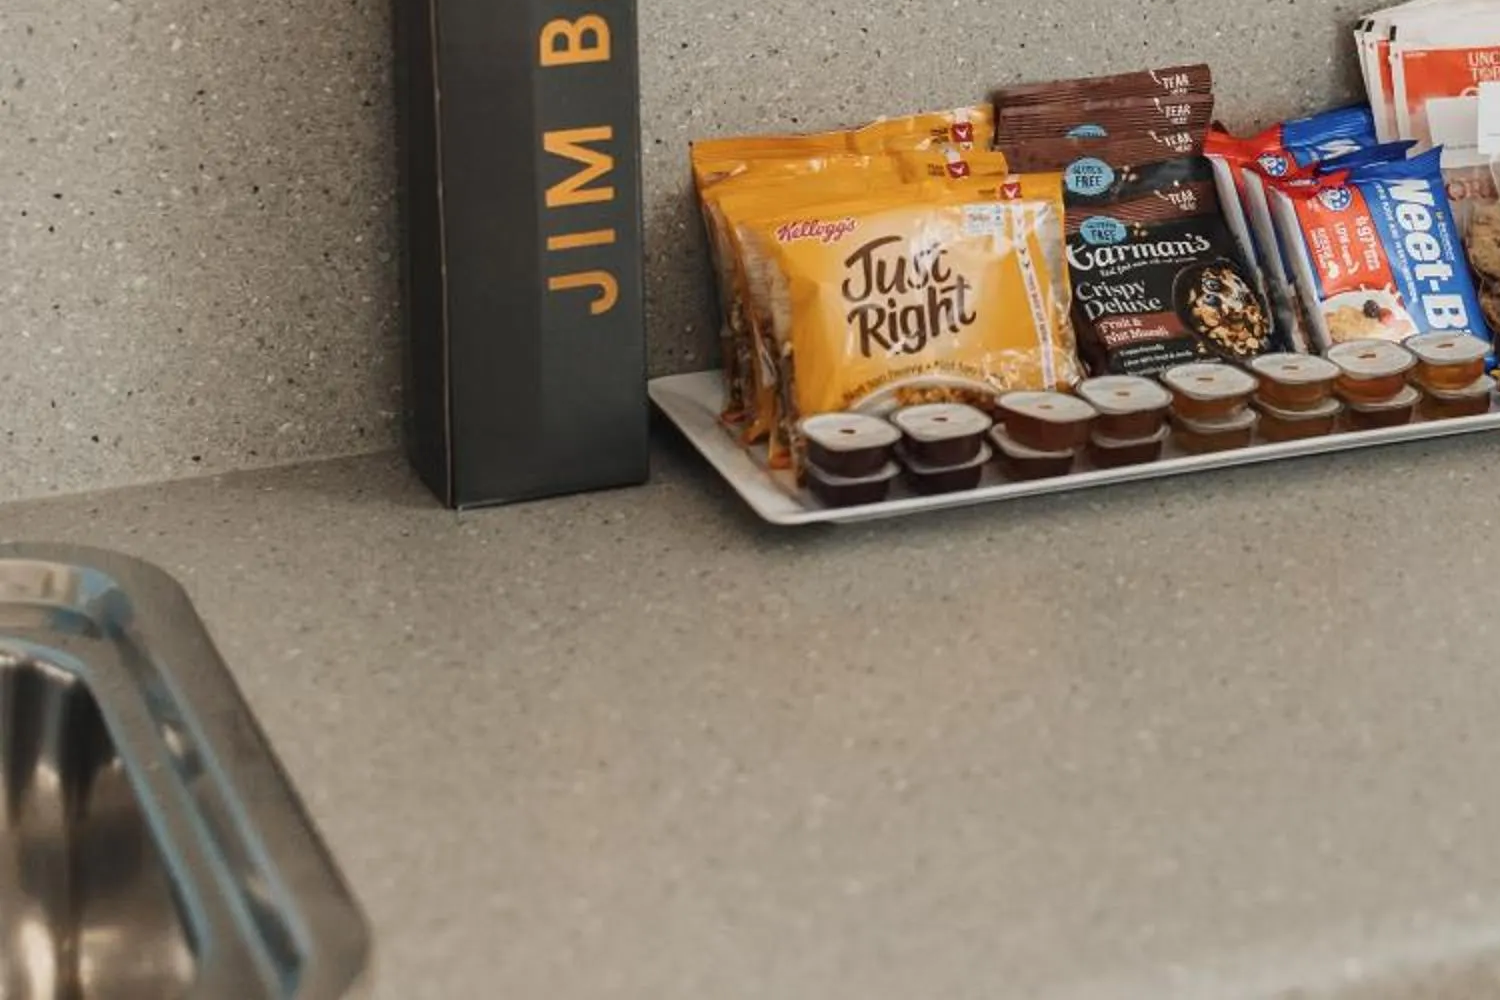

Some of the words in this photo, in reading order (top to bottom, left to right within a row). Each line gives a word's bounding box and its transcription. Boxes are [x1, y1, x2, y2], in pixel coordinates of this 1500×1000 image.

[1162, 73, 1190, 90] TEAR
[1165, 103, 1191, 118] TEAR
[1075, 175, 1102, 188] FREE
[543, 125, 618, 315] JIM
[777, 217, 858, 241] Kellogg's
[1066, 233, 1211, 271] Carman's
[1388, 179, 1471, 336] Weet-B
[842, 235, 951, 302] Just
[1076, 279, 1146, 301] Crispy
[847, 275, 977, 358] Right
[1085, 297, 1163, 321] Deluxe
[1100, 317, 1131, 333] Fruit
[1105, 330, 1130, 345] Nut
